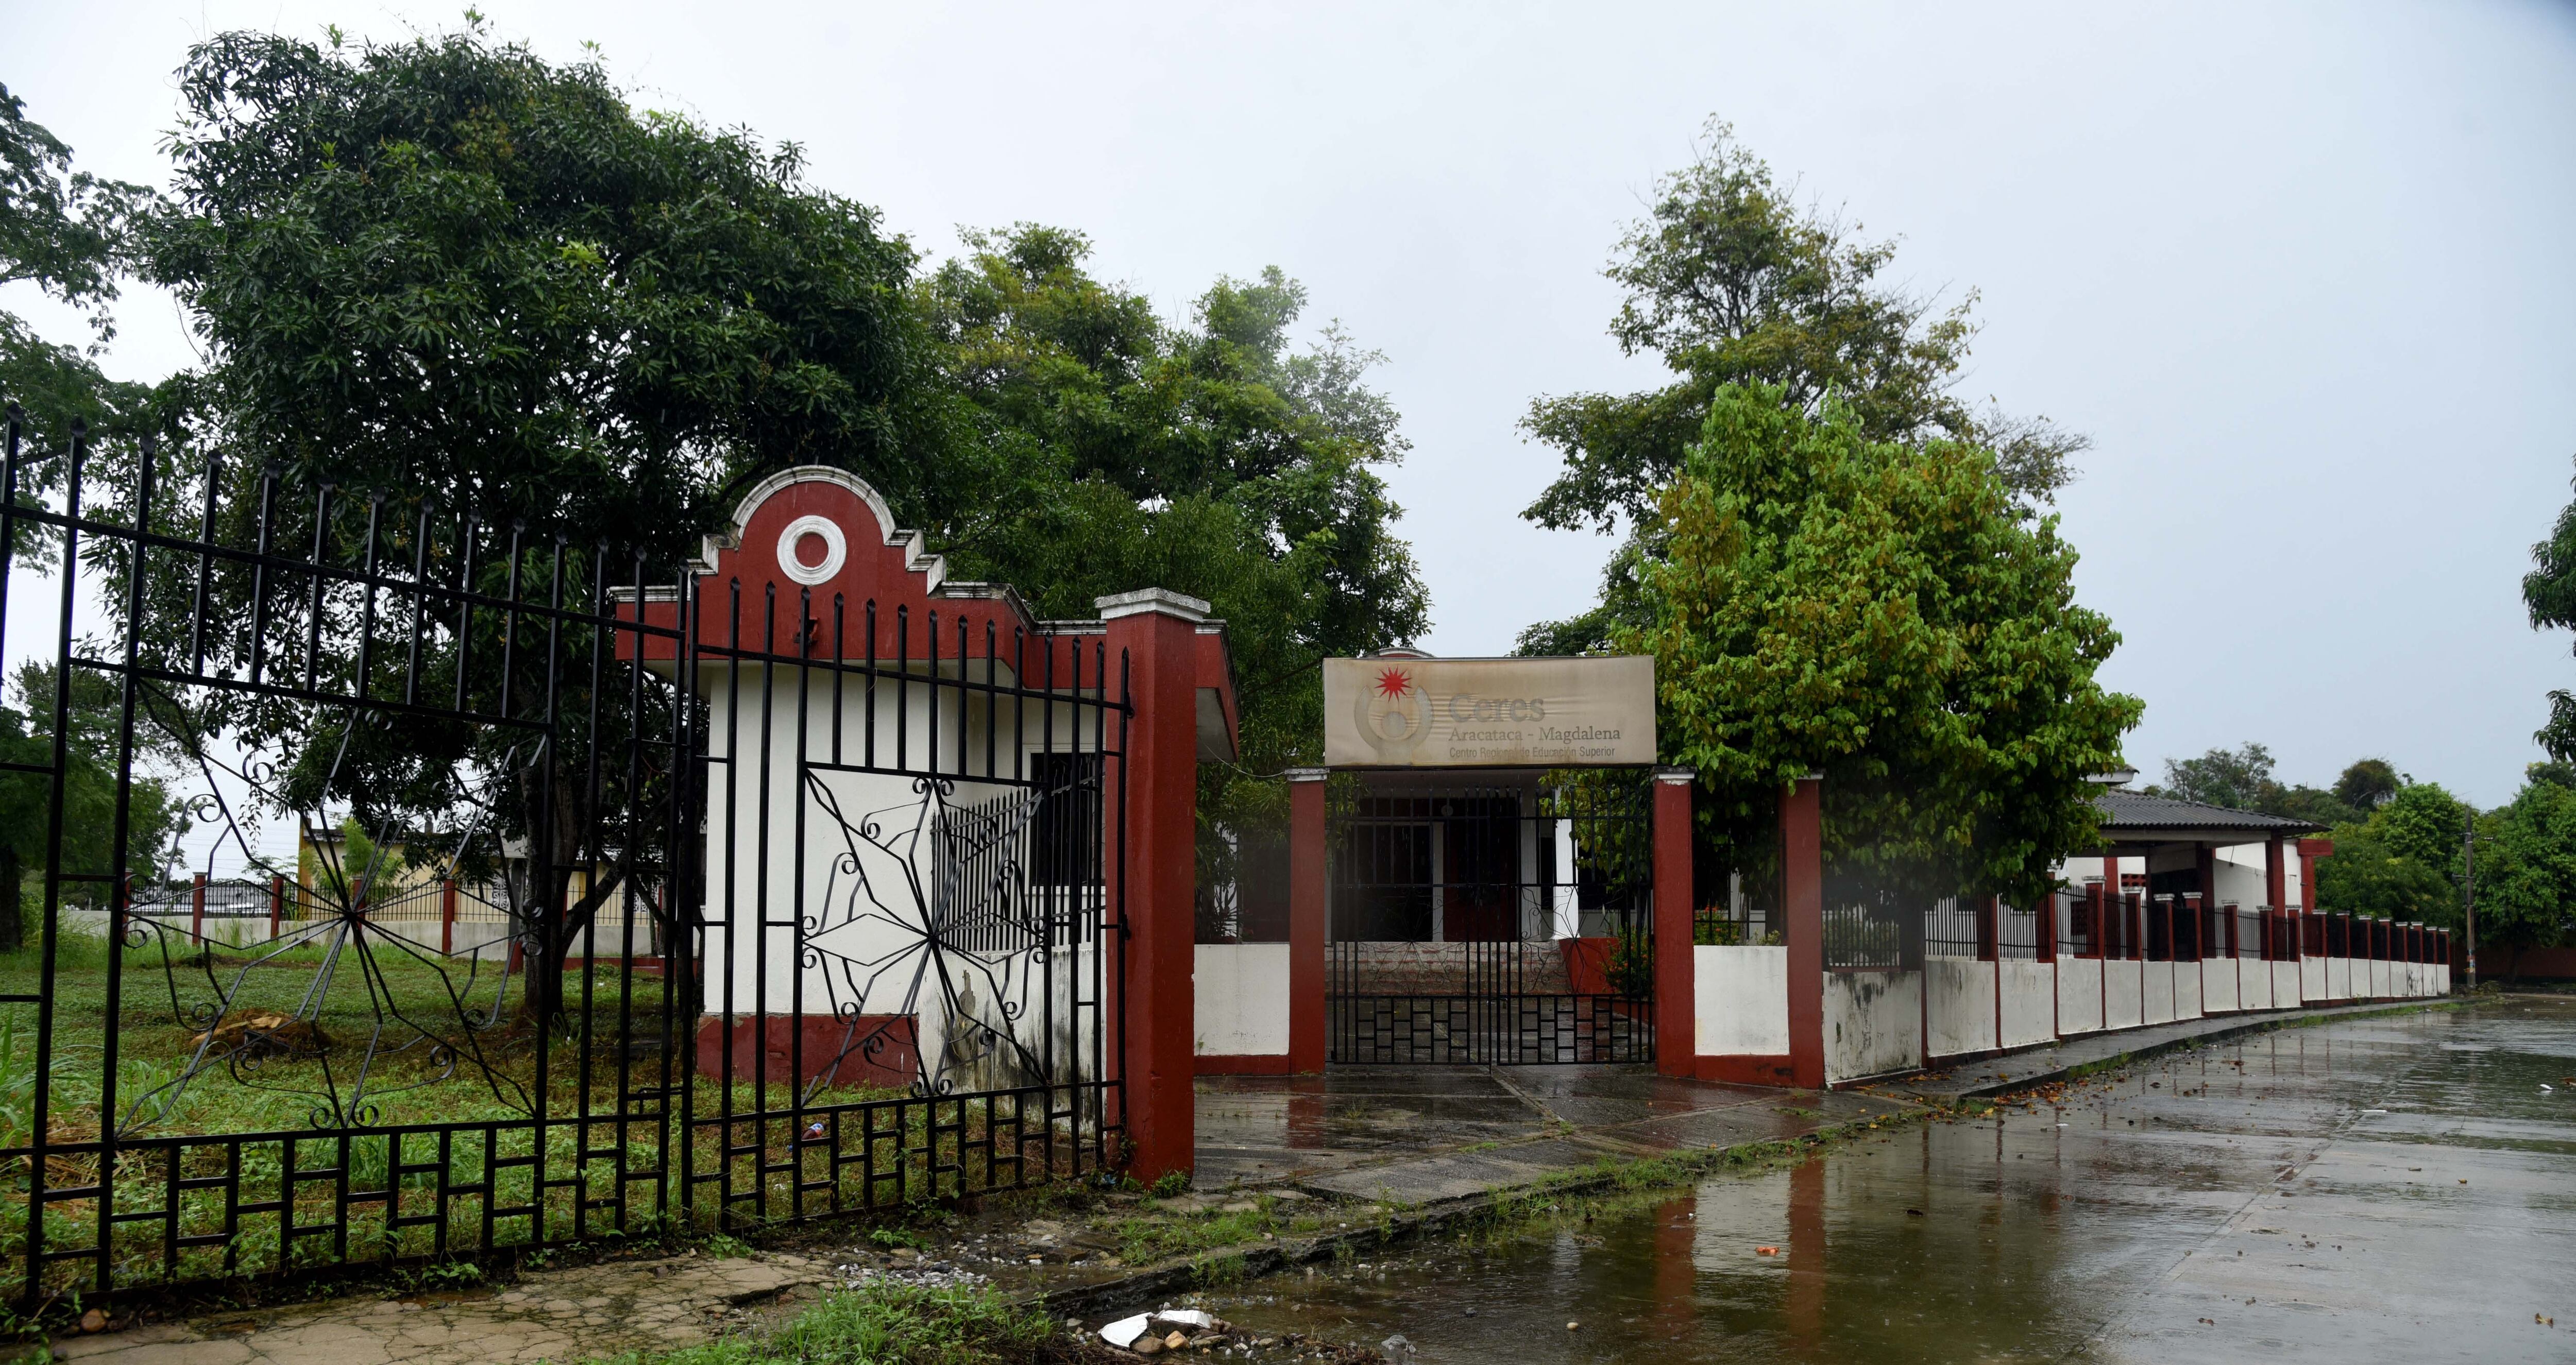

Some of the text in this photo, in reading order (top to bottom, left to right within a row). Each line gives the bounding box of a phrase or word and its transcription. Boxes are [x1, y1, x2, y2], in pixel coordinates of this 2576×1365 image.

[1449, 693, 1545, 722] Ceres
[1448, 727, 1523, 741] Aracataca
[1539, 726, 1621, 744] Magdalena
[1450, 747, 1478, 758] Centro
[1533, 746, 1577, 757] Educación
[1579, 746, 1615, 758] Superior
